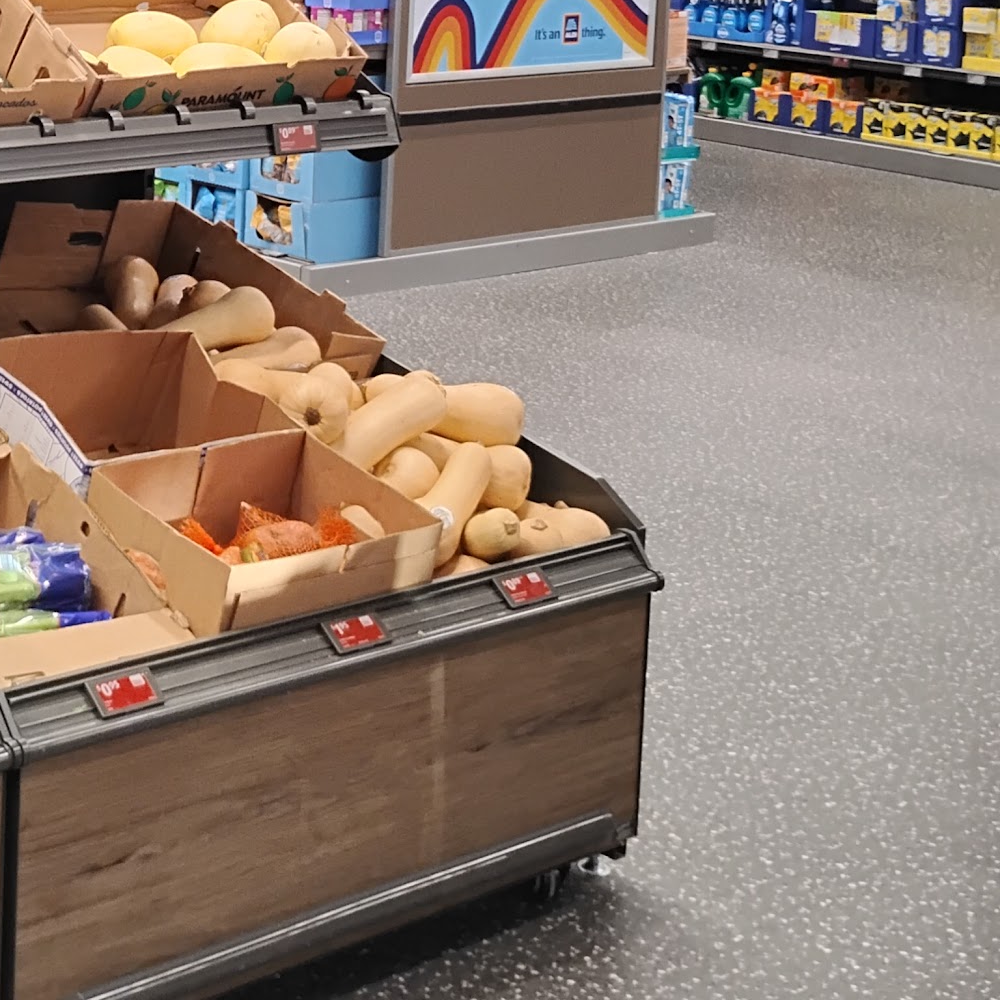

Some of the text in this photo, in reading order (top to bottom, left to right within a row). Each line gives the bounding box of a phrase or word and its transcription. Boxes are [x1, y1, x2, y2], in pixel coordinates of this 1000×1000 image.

[535, 29, 561, 41] It's an
[581, 26, 606, 40] thing.
